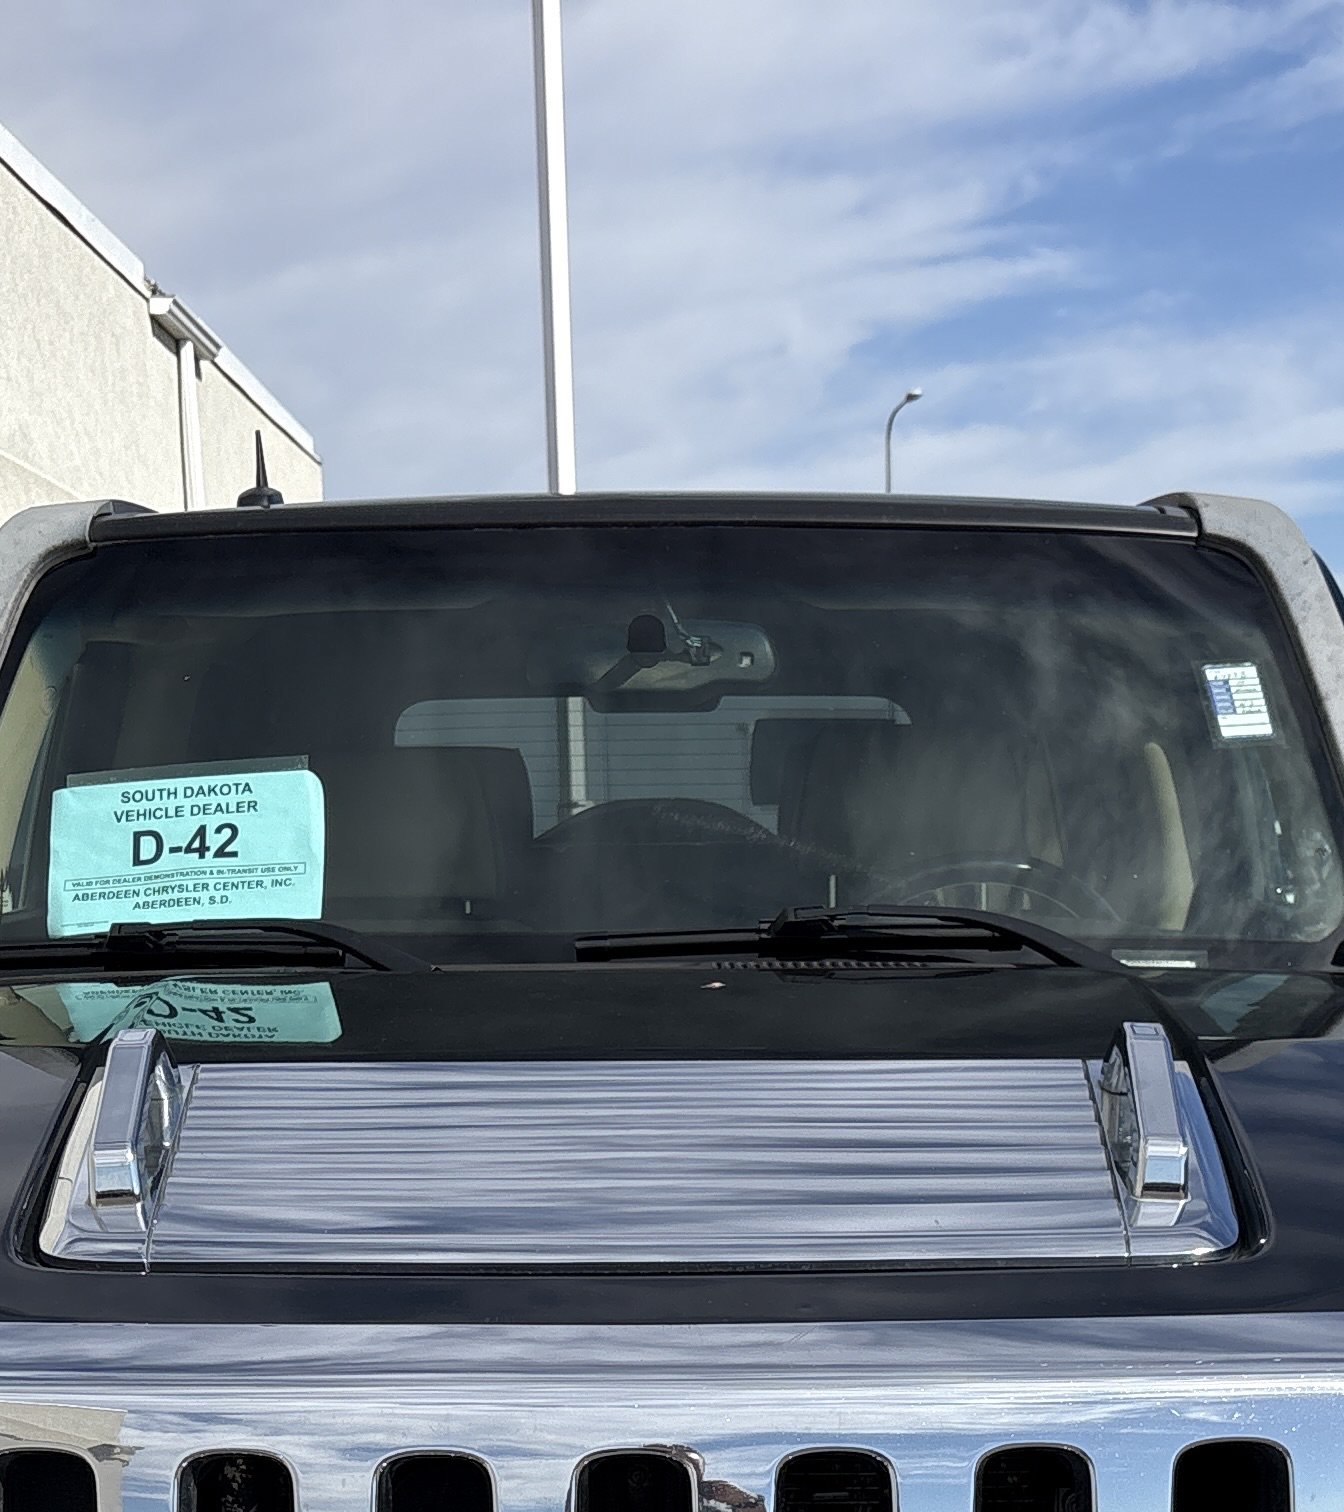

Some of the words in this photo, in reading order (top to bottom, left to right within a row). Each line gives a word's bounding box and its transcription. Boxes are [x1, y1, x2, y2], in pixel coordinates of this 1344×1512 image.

[120, 787, 178, 804] SOUTH
[183, 782, 253, 799] DAKOTA
[113, 805, 185, 823] VEHICLE
[189, 800, 258, 817] DEALER
[132, 822, 239, 867] D-42
[71, 880, 94, 888] VALID
[95, 879, 111, 887] FOR
[112, 877, 142, 886] DEALER
[260, 865, 276, 874] USE
[72, 889, 140, 902] ABERDEEN
[143, 882, 210, 897] CHRYSLER
[213, 879, 267, 892] CENTER,
[270, 878, 296, 888] INC.
[132, 896, 205, 910] ABERDEEN,
[208, 895, 233, 906] S.D.
